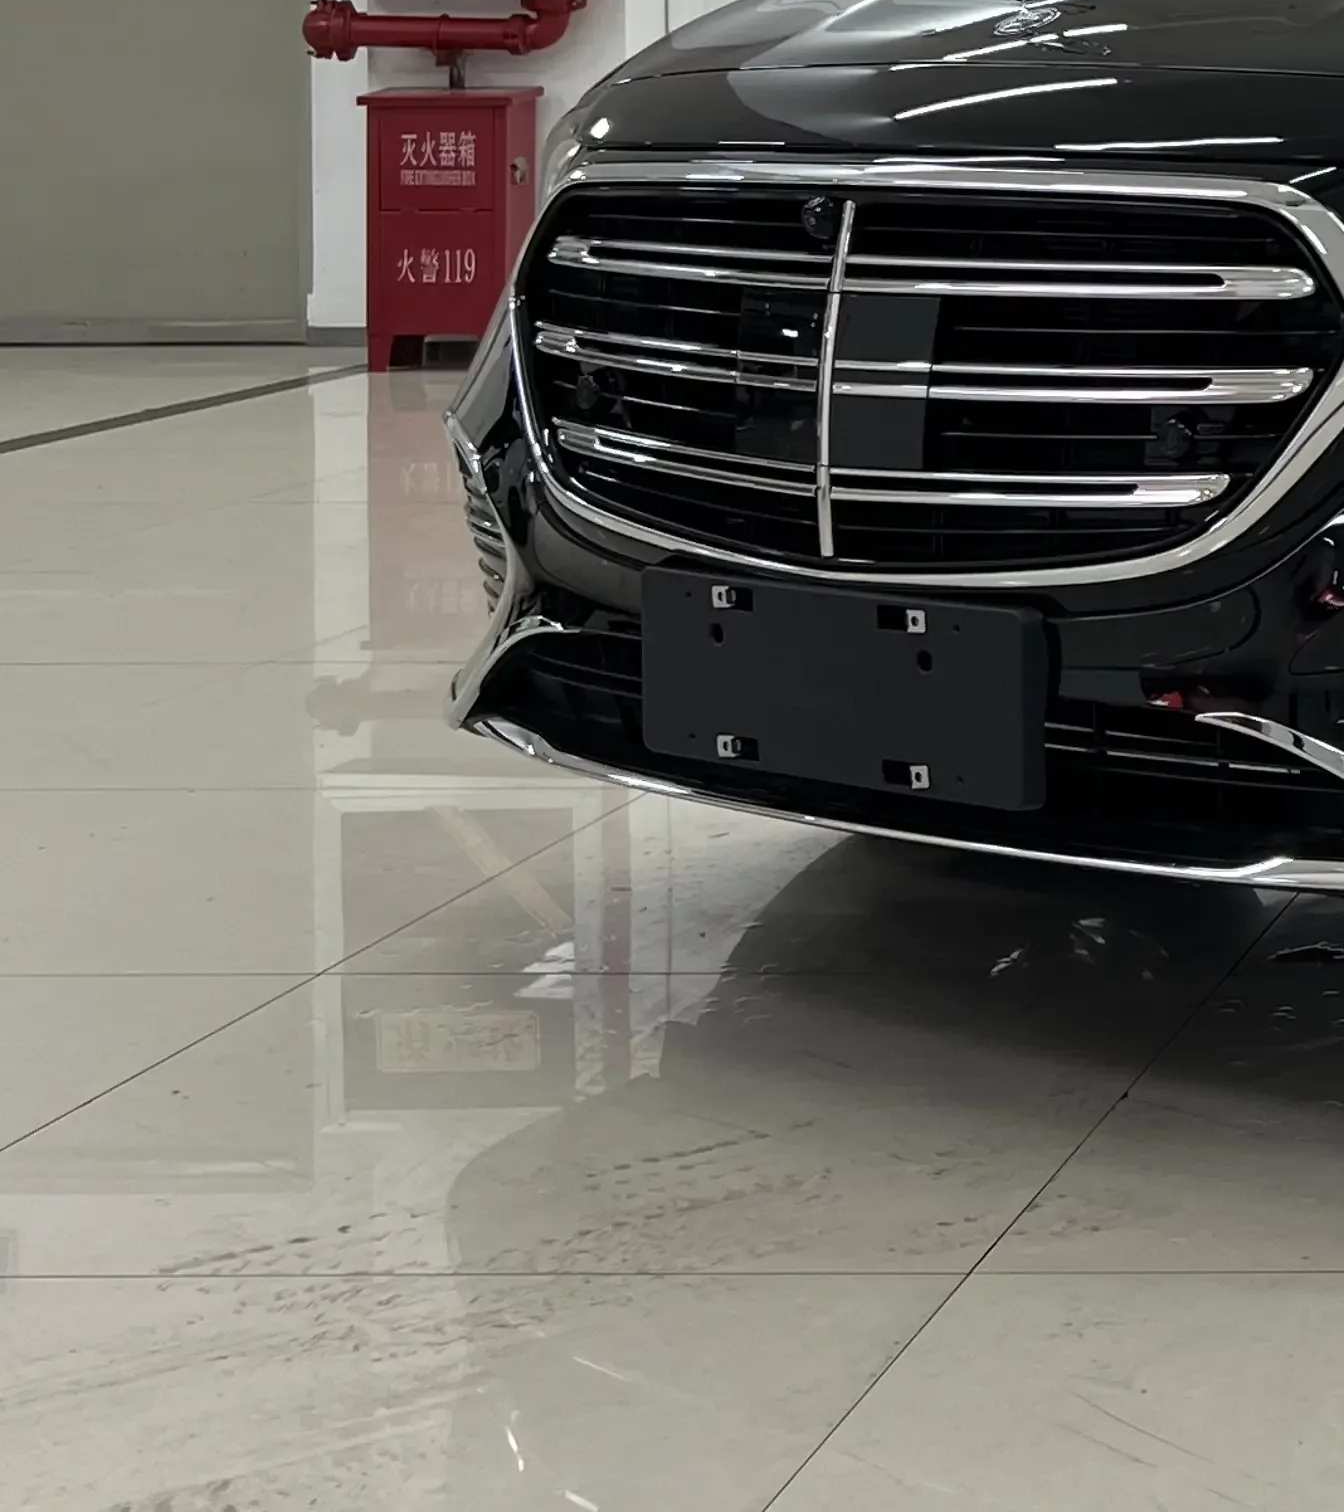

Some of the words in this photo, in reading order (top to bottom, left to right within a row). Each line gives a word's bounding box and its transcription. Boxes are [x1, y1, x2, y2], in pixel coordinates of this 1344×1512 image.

[400, 130, 477, 167] 灭火器箱
[397, 247, 477, 283] 火警119
